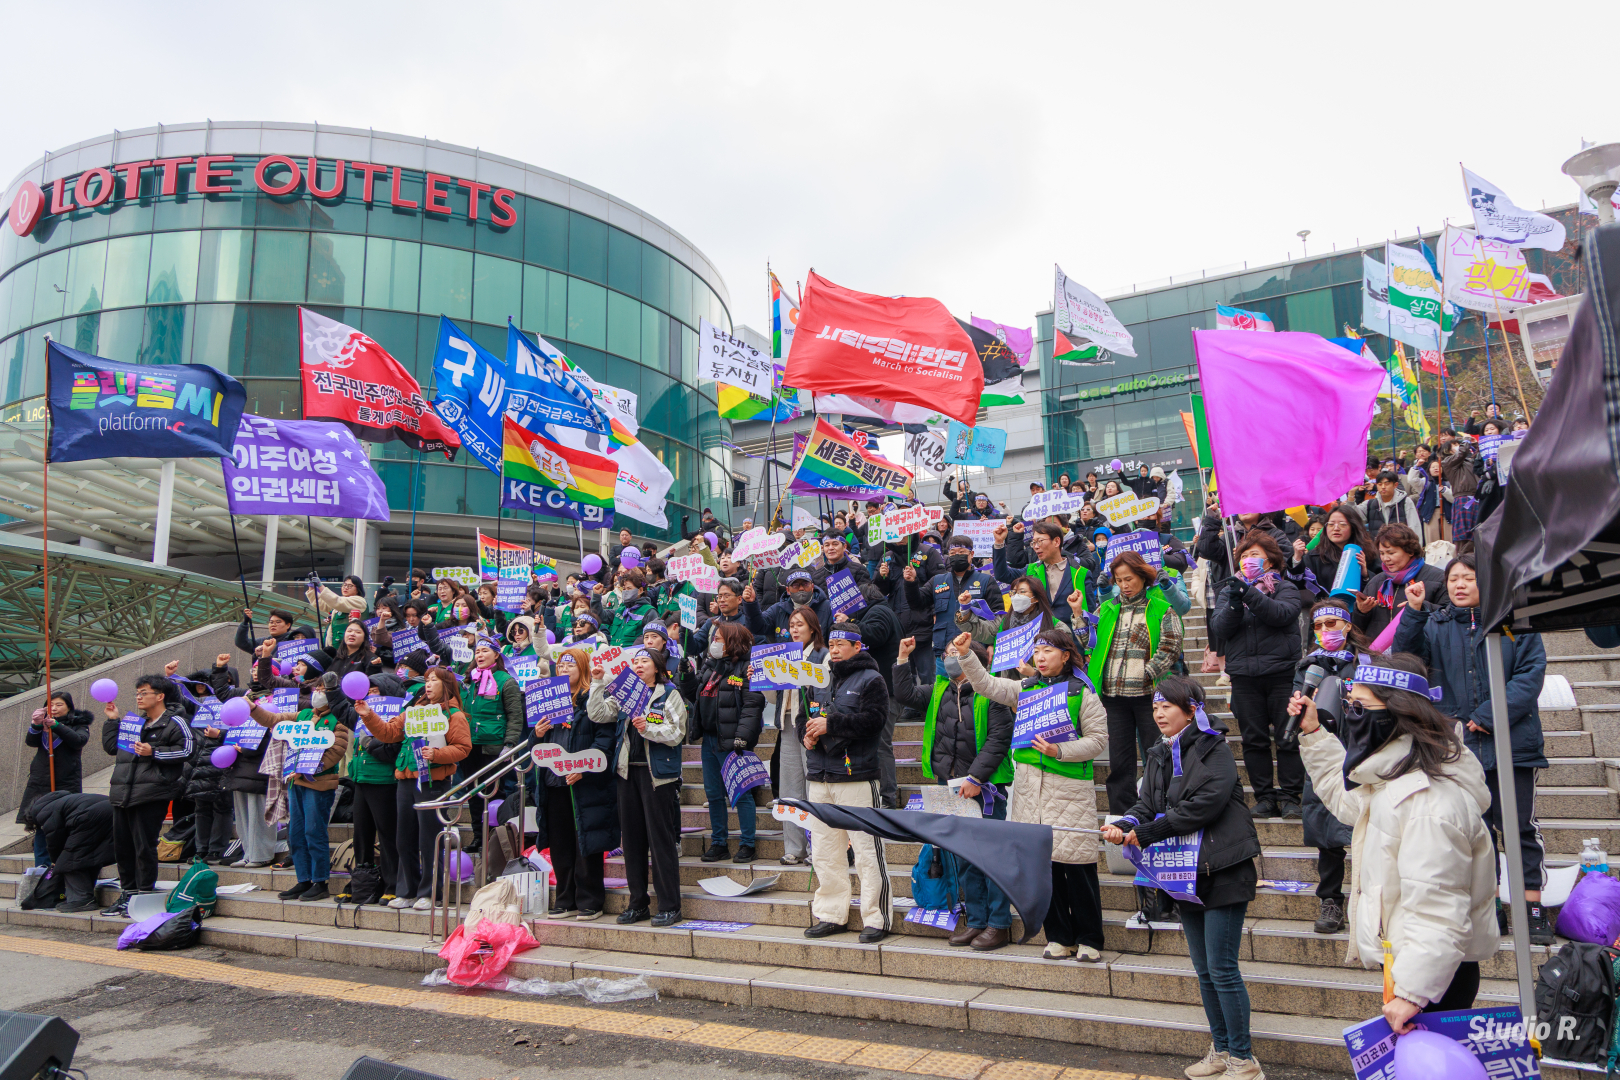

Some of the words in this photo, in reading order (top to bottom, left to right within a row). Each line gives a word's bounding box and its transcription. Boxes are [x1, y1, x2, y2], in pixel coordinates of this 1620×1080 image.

[51, 156, 234, 215] LOTTE
[254, 155, 517, 228] OUTLETS
[1409, 298, 1439, 318] 살맛
[711, 361, 758, 387] 동지회
[872, 357, 901, 372] March
[904, 364, 914, 375] to
[915, 367, 963, 382] Socialism
[1116, 372, 1185, 393] autoOasis
[99, 411, 186, 436] platform.c
[358, 406, 421, 432] 톨게이트지부
[231, 444, 338, 475] 이주여성
[814, 438, 909, 490] 세종호텔지부
[231, 476, 340, 506] 인권센터
[885, 505, 922, 528] 차별금지법
[1133, 537, 1159, 551] 여기에
[832, 575, 853, 594] 여기에
[994, 640, 1009, 655] 지금
[1011, 634, 1025, 648] 바로
[592, 647, 622, 667] 차별의
[993, 650, 1018, 665] 실질적
[1354, 665, 1410, 689] 여성파업
[543, 683, 570, 699] 여기에
[538, 695, 573, 716] 성평등을!
[1015, 706, 1030, 723] 지금
[1030, 701, 1043, 717] 바로
[1043, 691, 1067, 711] 여기에
[1033, 707, 1073, 731] 성평등을!
[1151, 849, 1198, 868] 성평등을!
[1178, 871, 1195, 881] 바꾼다!
[1354, 1040, 1389, 1071] 바꾼다!
